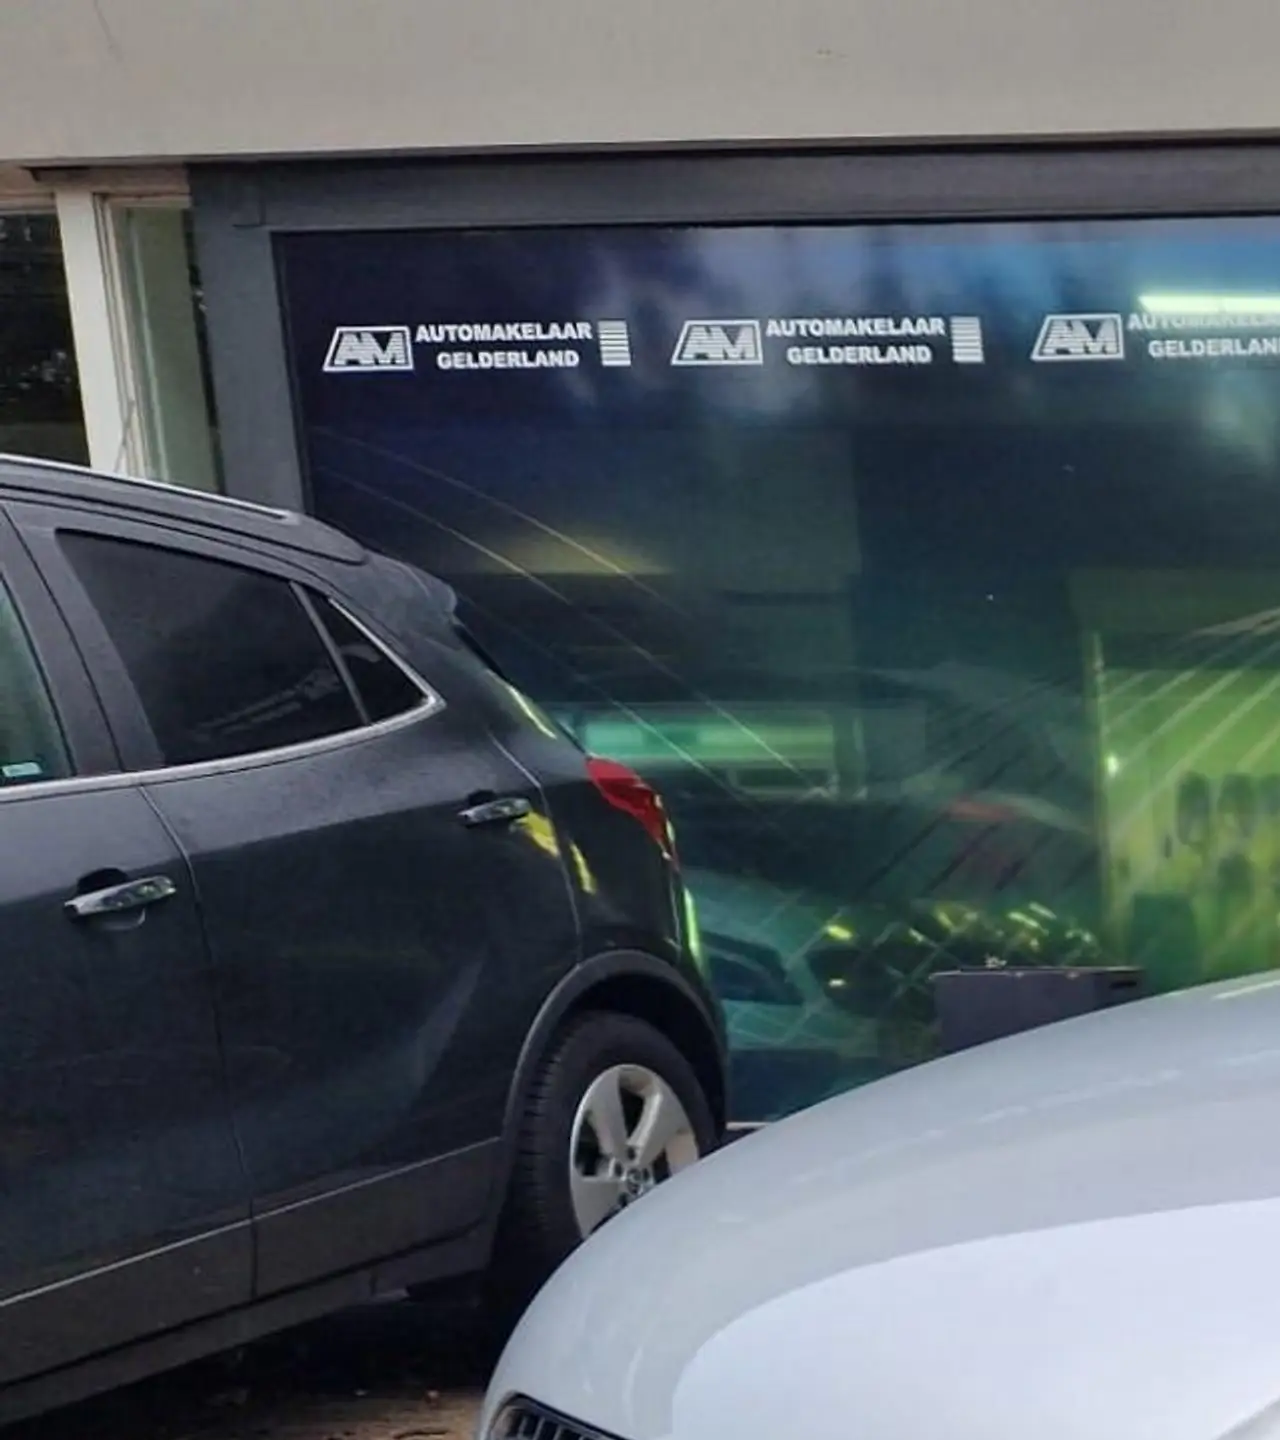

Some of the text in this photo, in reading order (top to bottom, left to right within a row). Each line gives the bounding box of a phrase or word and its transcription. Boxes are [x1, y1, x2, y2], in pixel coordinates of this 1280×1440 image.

[415, 321, 592, 343] AUTOMAKELAAR
[765, 316, 946, 337] AUTOMAKELAAR
[436, 350, 580, 369] GELDERLAND
[786, 345, 932, 364] GELDERLAND
